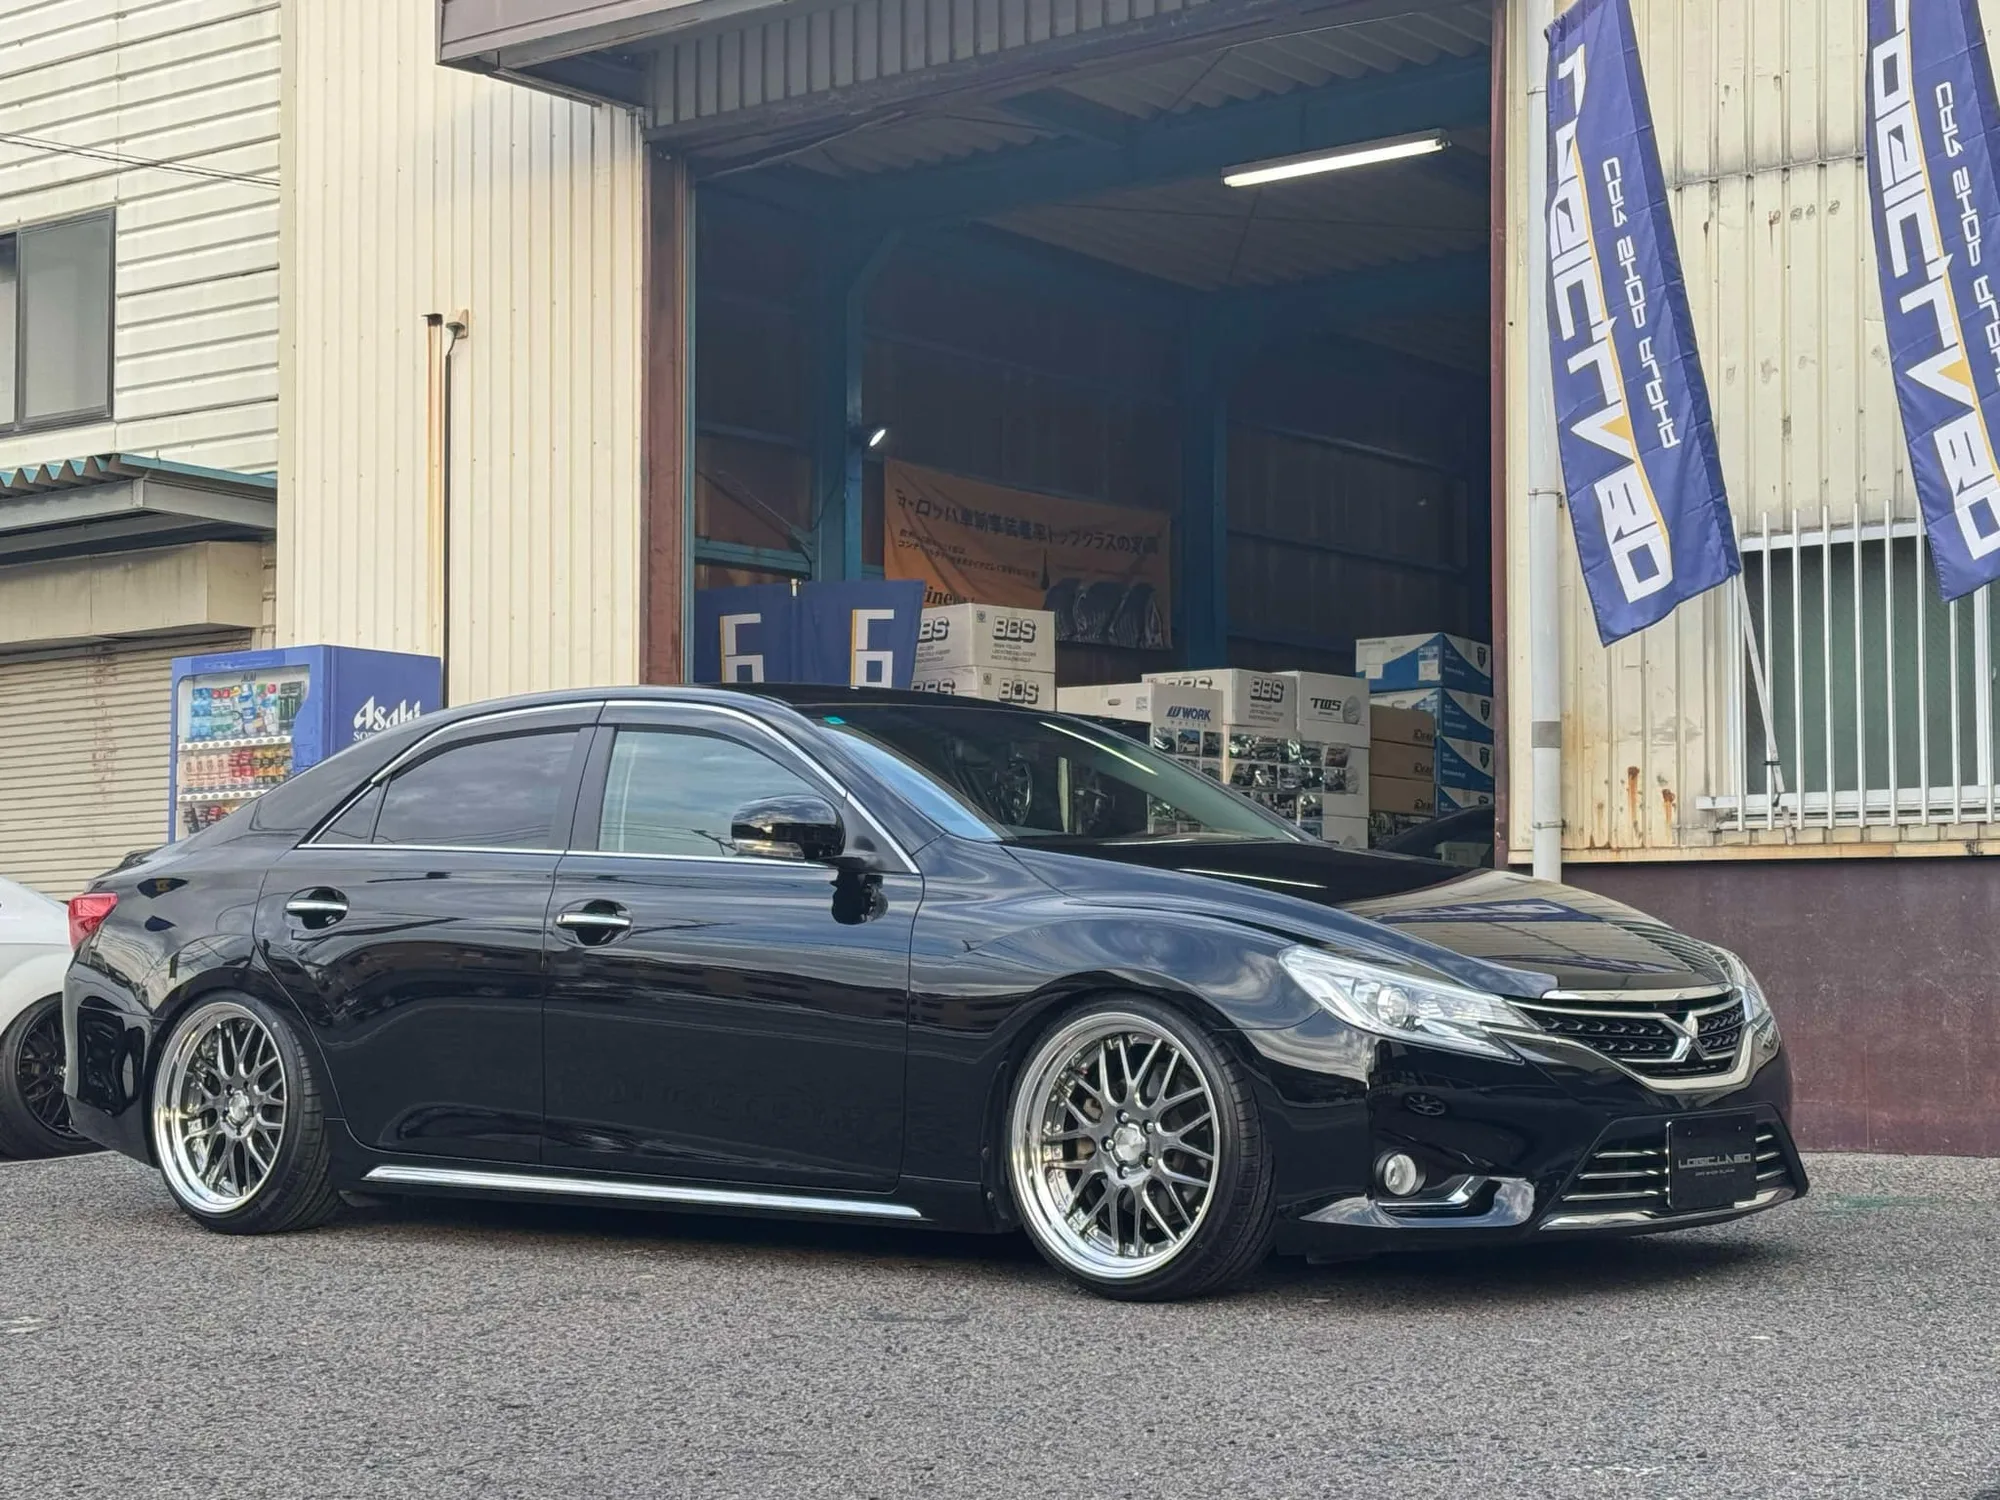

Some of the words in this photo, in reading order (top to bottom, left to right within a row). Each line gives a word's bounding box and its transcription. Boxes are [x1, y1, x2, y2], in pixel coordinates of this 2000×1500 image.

[918, 616, 950, 642] BS
[992, 616, 1037, 643] BBS
[998, 678, 1039, 704] BBS
[1250, 676, 1285, 703] BBS
[353, 695, 421, 731] Asahi
[1182, 706, 1211, 721] WORK
[1310, 697, 1342, 712] TWS
